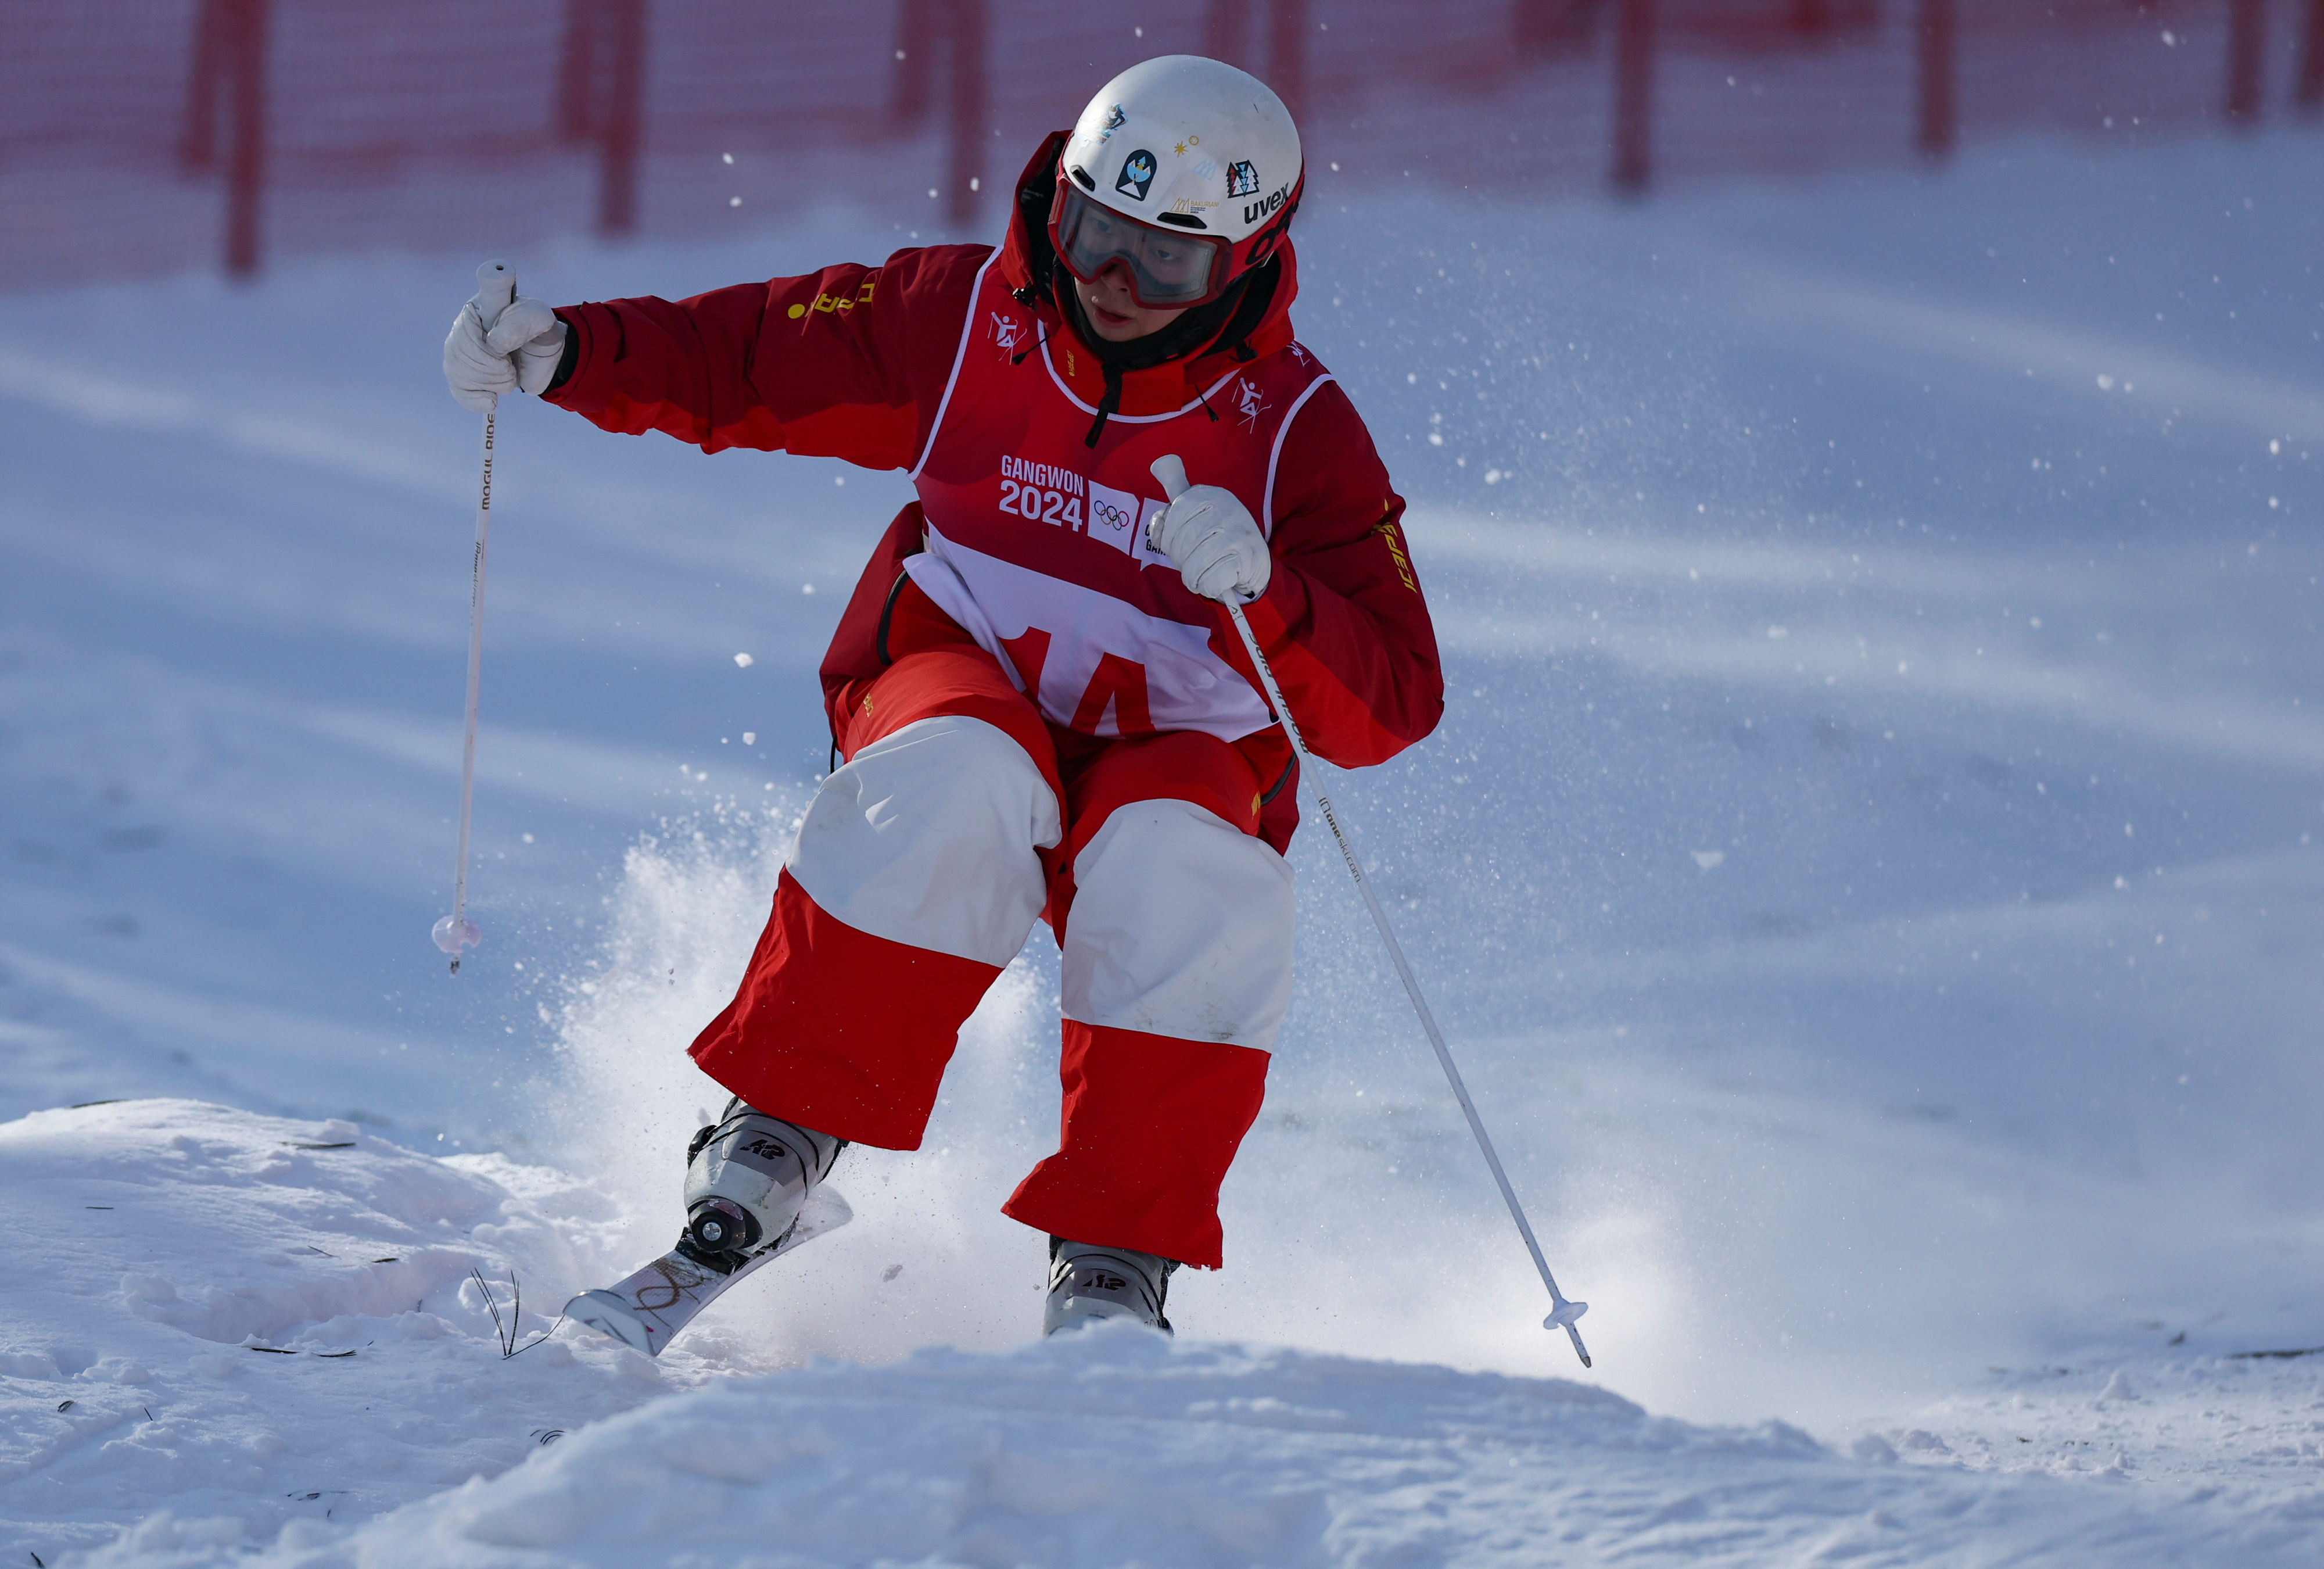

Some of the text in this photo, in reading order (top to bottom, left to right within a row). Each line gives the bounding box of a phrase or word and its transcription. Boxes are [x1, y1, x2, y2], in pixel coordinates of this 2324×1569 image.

[1244, 182, 1289, 224] uvex
[482, 413, 495, 510] MOGUL RIDE
[1001, 454, 1084, 497] GANGWON
[999, 479, 1083, 532] 2024
